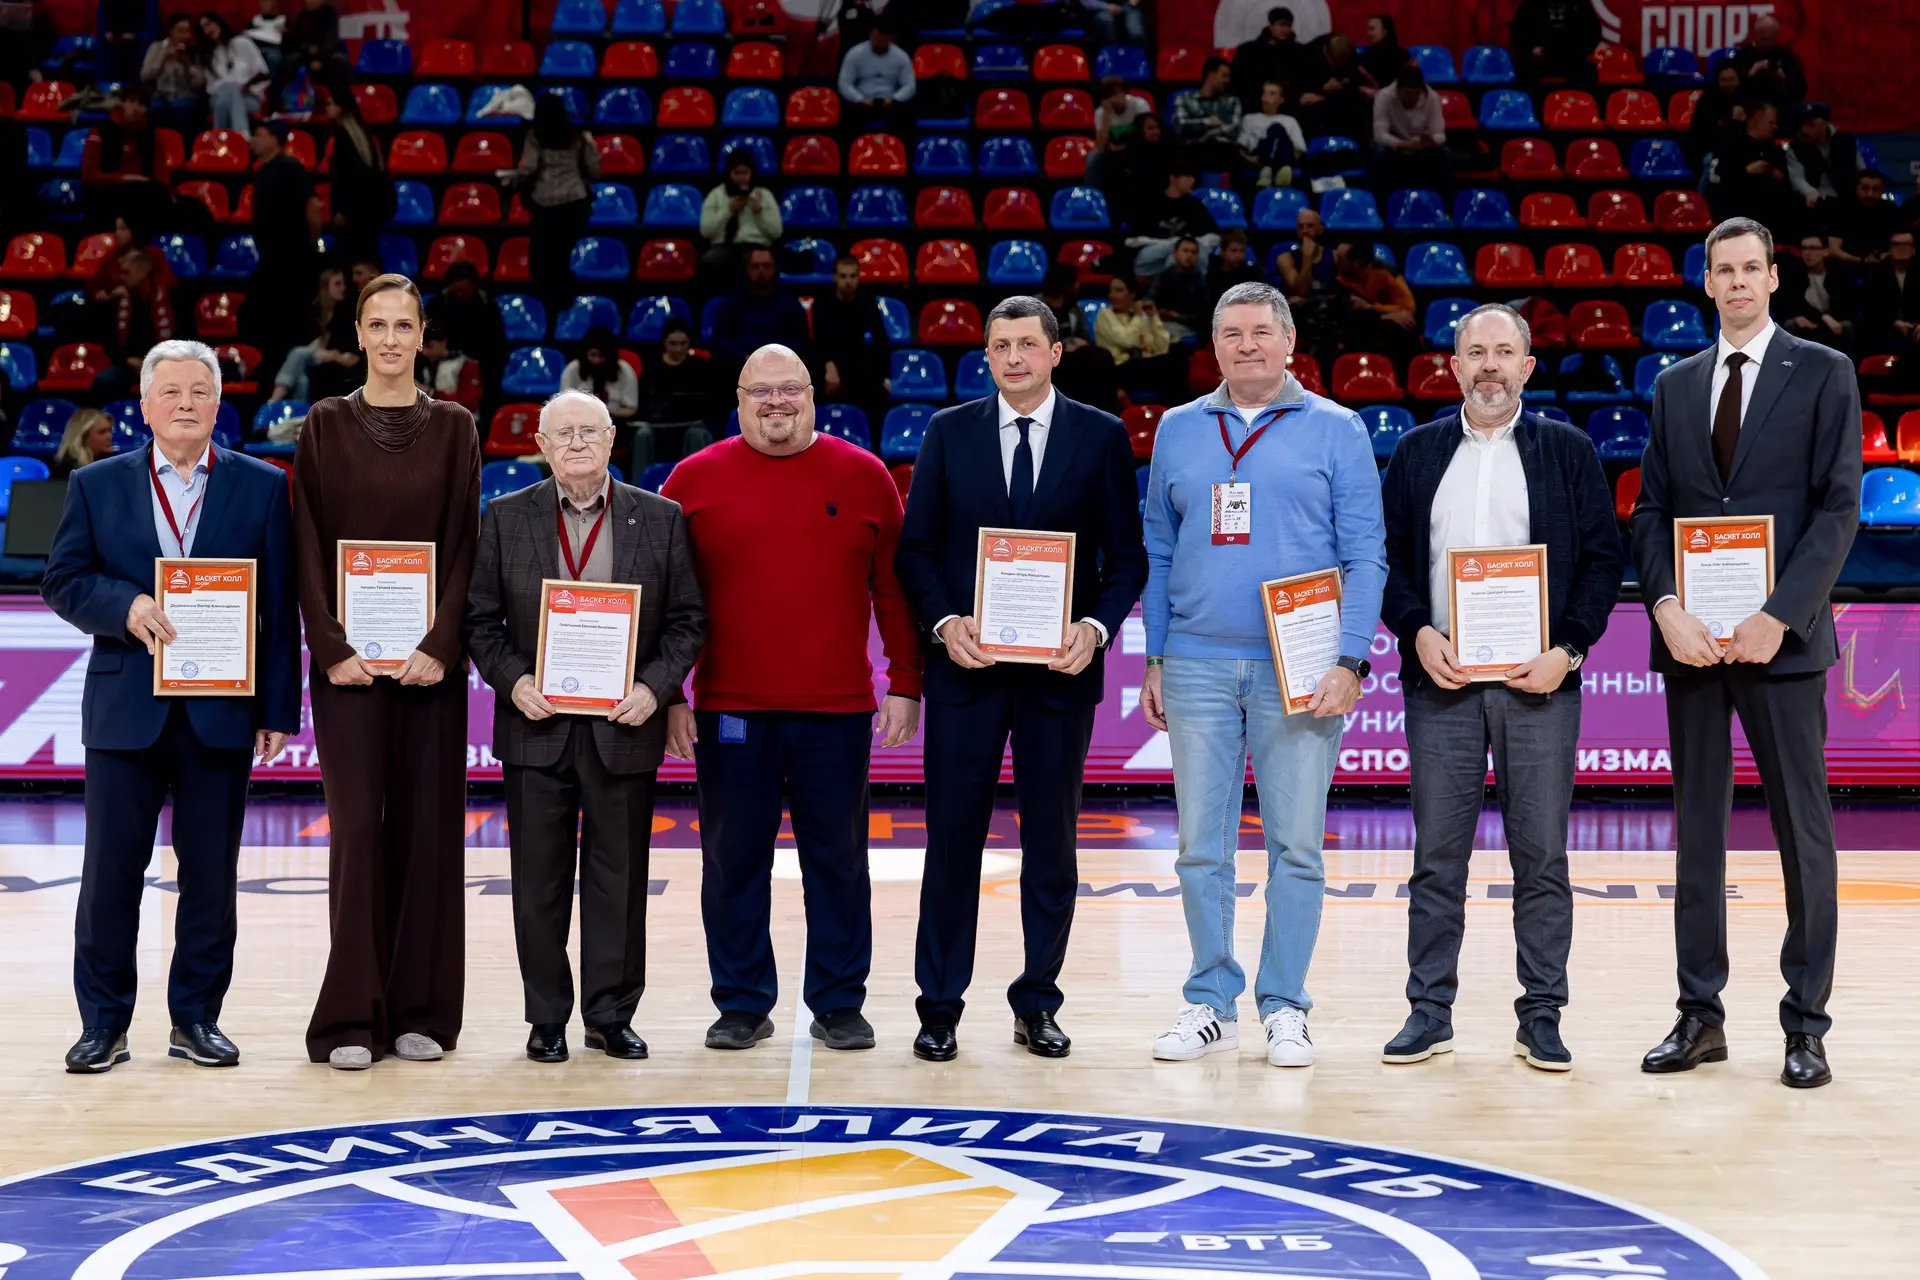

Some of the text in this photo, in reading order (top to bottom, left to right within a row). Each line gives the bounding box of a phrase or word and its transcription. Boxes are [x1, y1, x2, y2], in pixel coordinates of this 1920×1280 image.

[1293, 585, 1330, 599] БАСКЕТ ХОЛЛ
[580, 596, 607, 604] БАСКЕТ
[80, 1114, 1482, 1199] ЕДИНАЯ ЛИГА ВТБ
[1181, 1234, 1333, 1251] ВТБ
